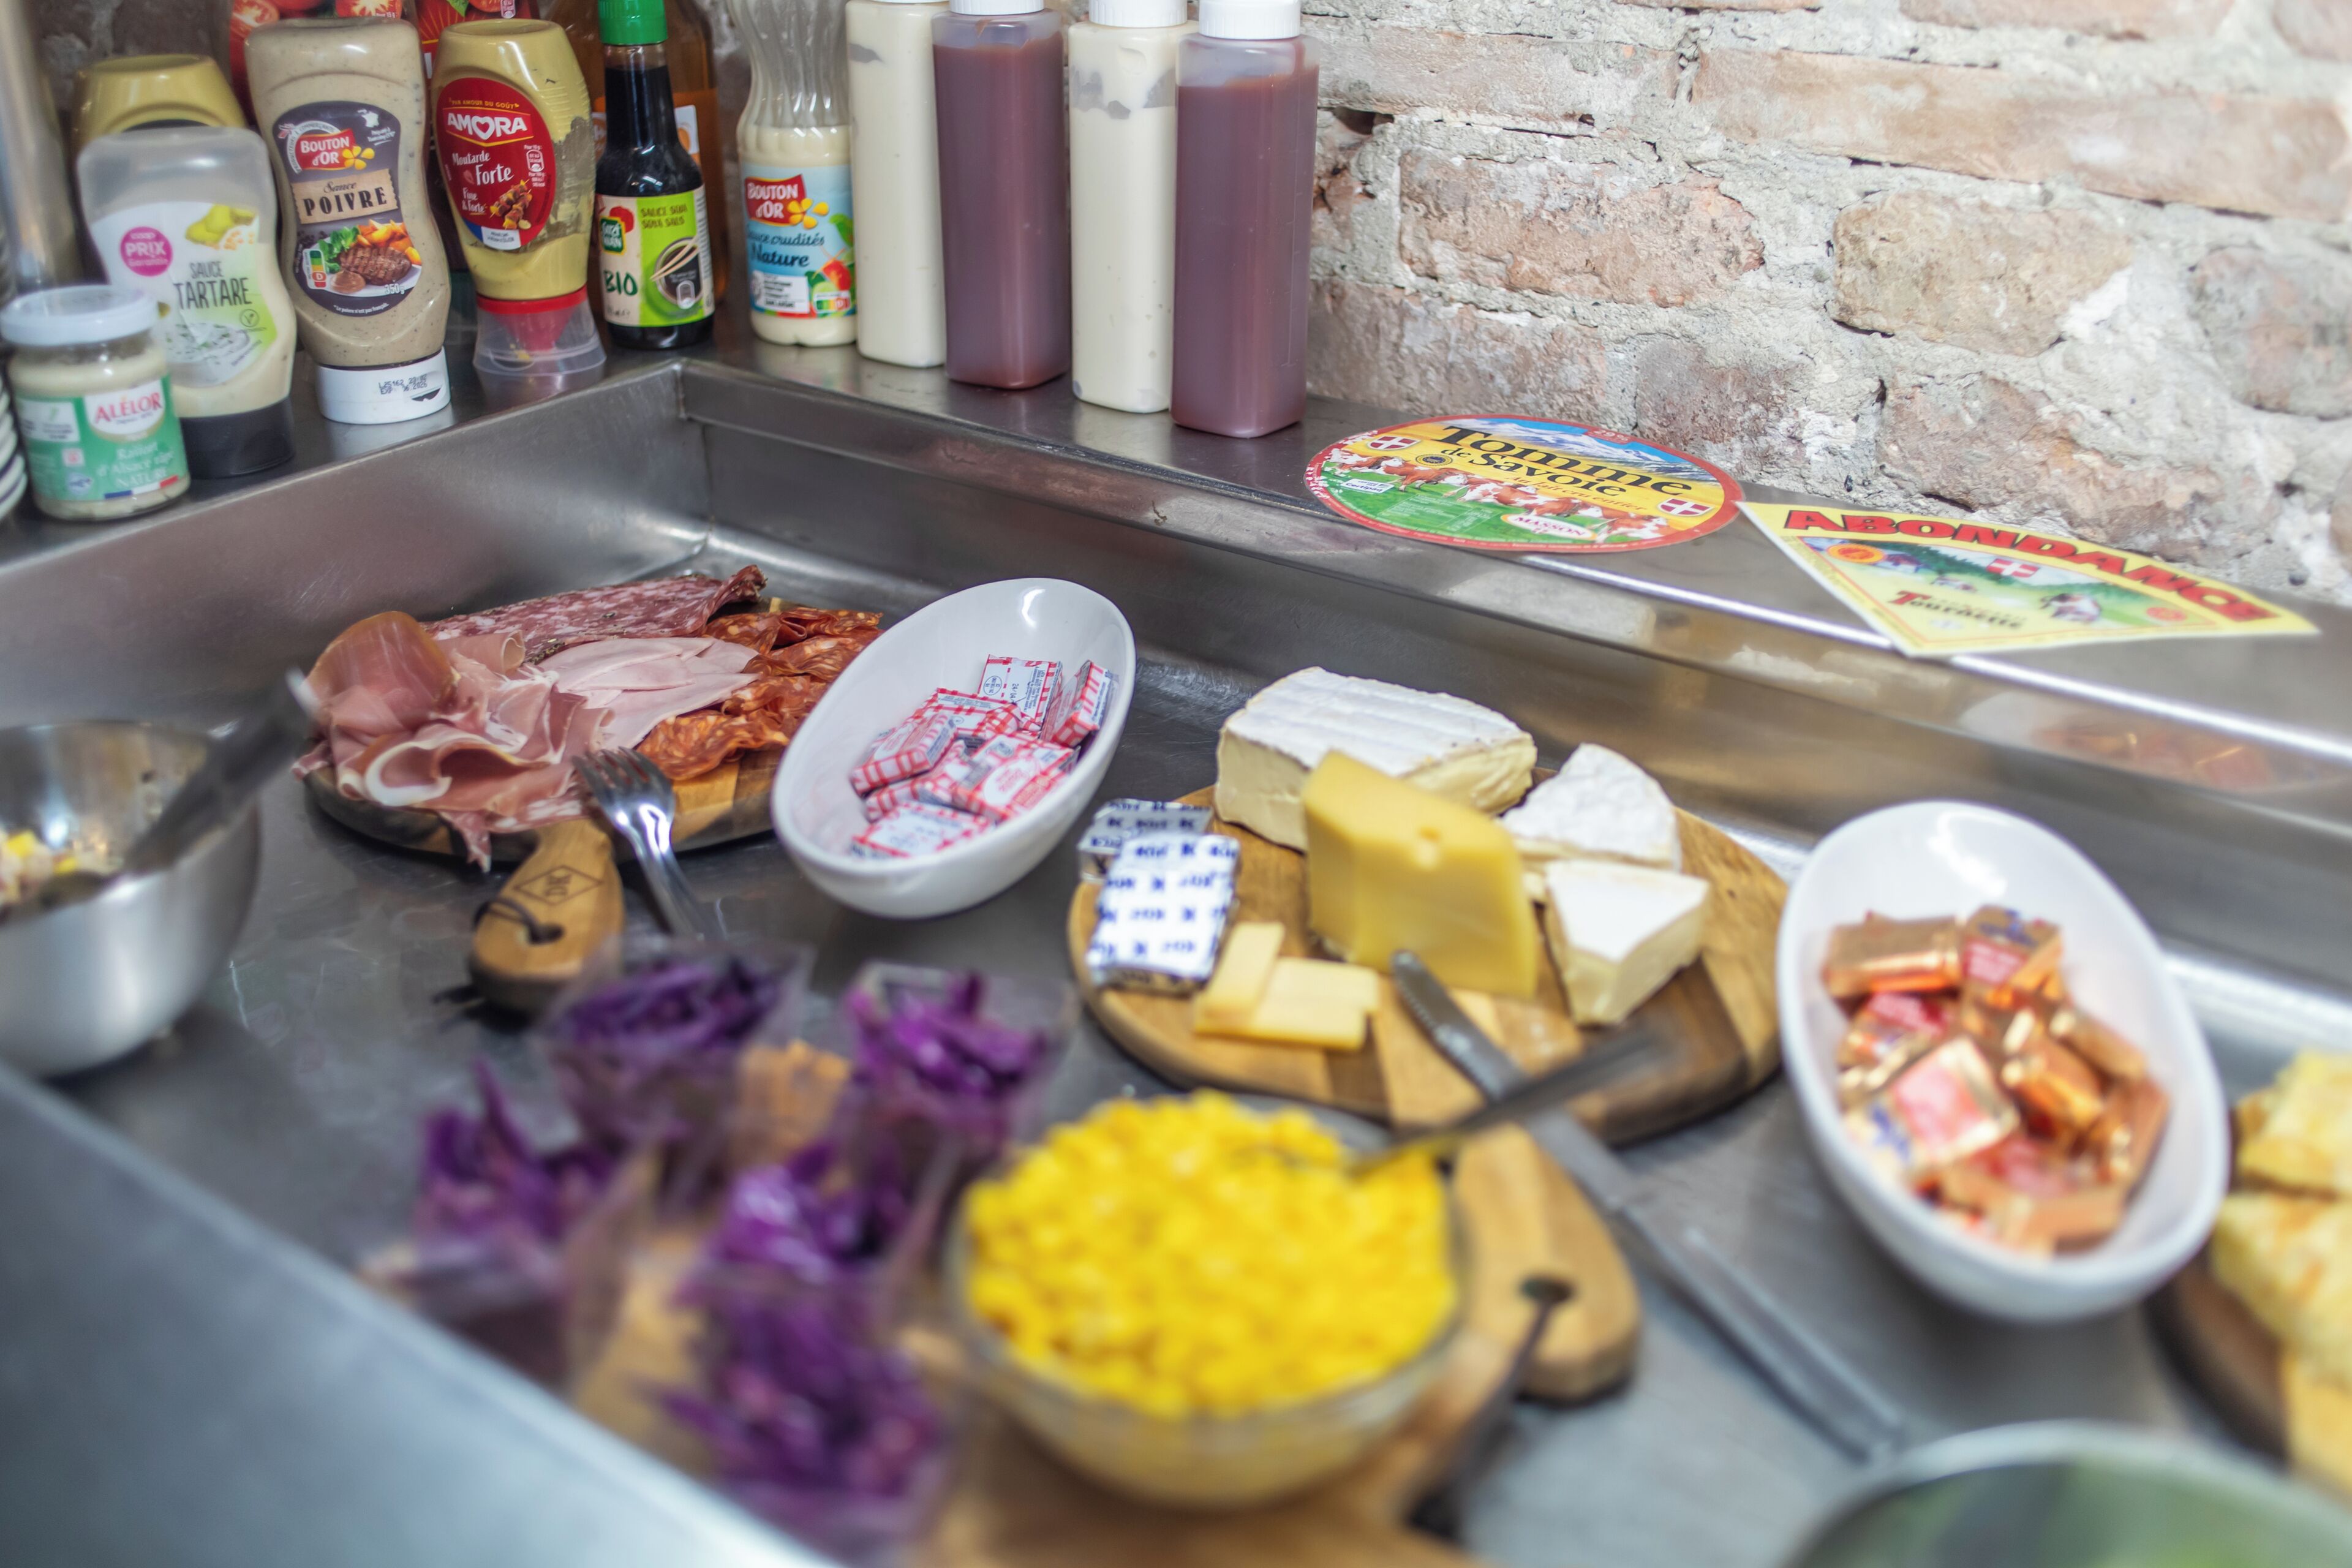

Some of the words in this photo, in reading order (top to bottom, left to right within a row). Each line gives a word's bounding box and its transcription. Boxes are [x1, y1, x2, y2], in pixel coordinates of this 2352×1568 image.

[447, 112, 528, 140] AMORA
[300, 136, 350, 154] BOUTON
[452, 149, 491, 167] Moutarde
[475, 163, 514, 186] Forte
[323, 181, 357, 194] Sauce
[462, 187, 478, 201] Fine
[747, 183, 799, 200] BOUTON
[303, 186, 387, 217] POIVRE
[467, 199, 486, 213] Forte
[752, 243, 810, 268] Nature
[189, 260, 224, 279] SAUCE
[173, 277, 253, 310] TARTARE
[603, 269, 638, 296] BIO
[1431, 426, 1692, 496] Tomme
[1441, 448, 1472, 458] de
[1468, 453, 1626, 496] Savoie
[1532, 481, 1561, 491] lait
[1561, 489, 1591, 498] cru
[1592, 496, 1647, 511] entier
[1784, 510, 2280, 622] ABONDANCE
